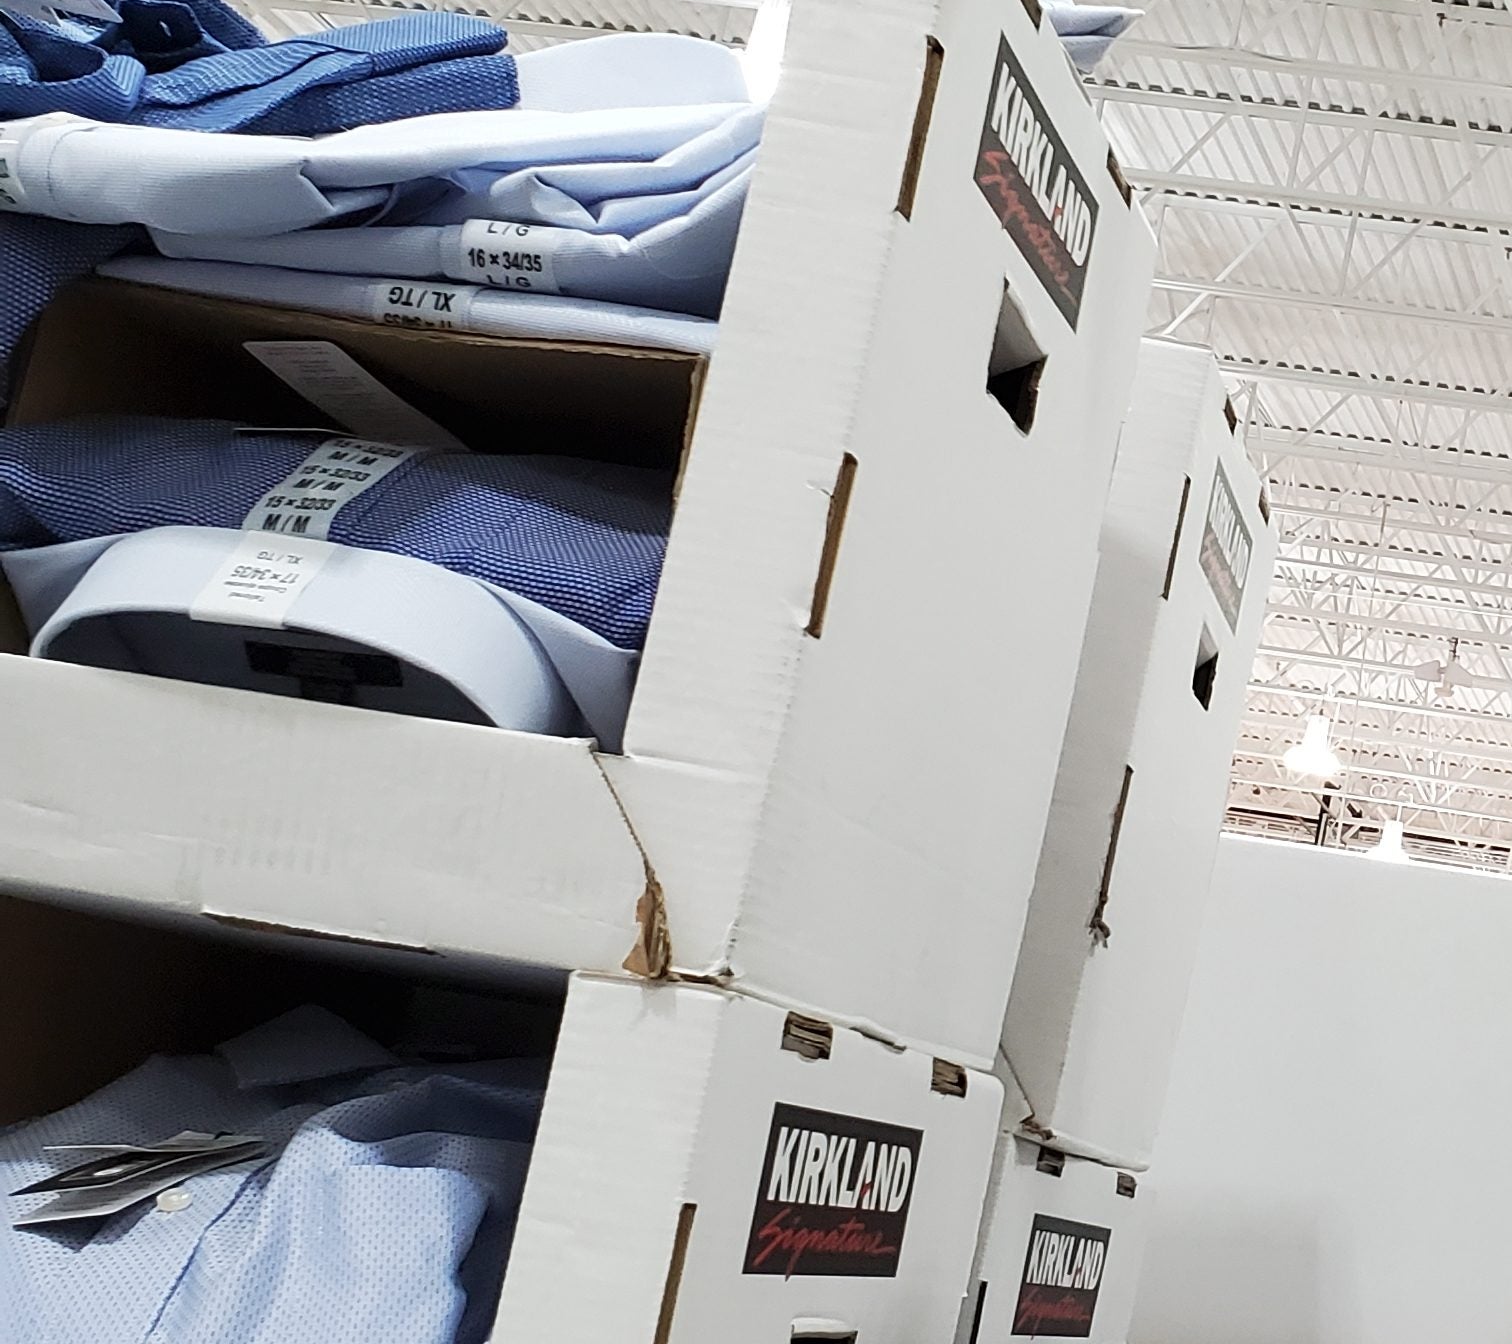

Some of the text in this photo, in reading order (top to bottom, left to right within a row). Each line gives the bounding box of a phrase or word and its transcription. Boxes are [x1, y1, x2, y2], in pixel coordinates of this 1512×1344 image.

[988, 61, 1093, 268] KIRKLAND
[468, 248, 542, 273] 16 34/35
[1208, 474, 1253, 591] KIRKLAND
[766, 1126, 913, 1213] KIRKLAND
[754, 1208, 896, 1282] Signature
[1026, 1229, 1105, 1291] KIRKLAND
